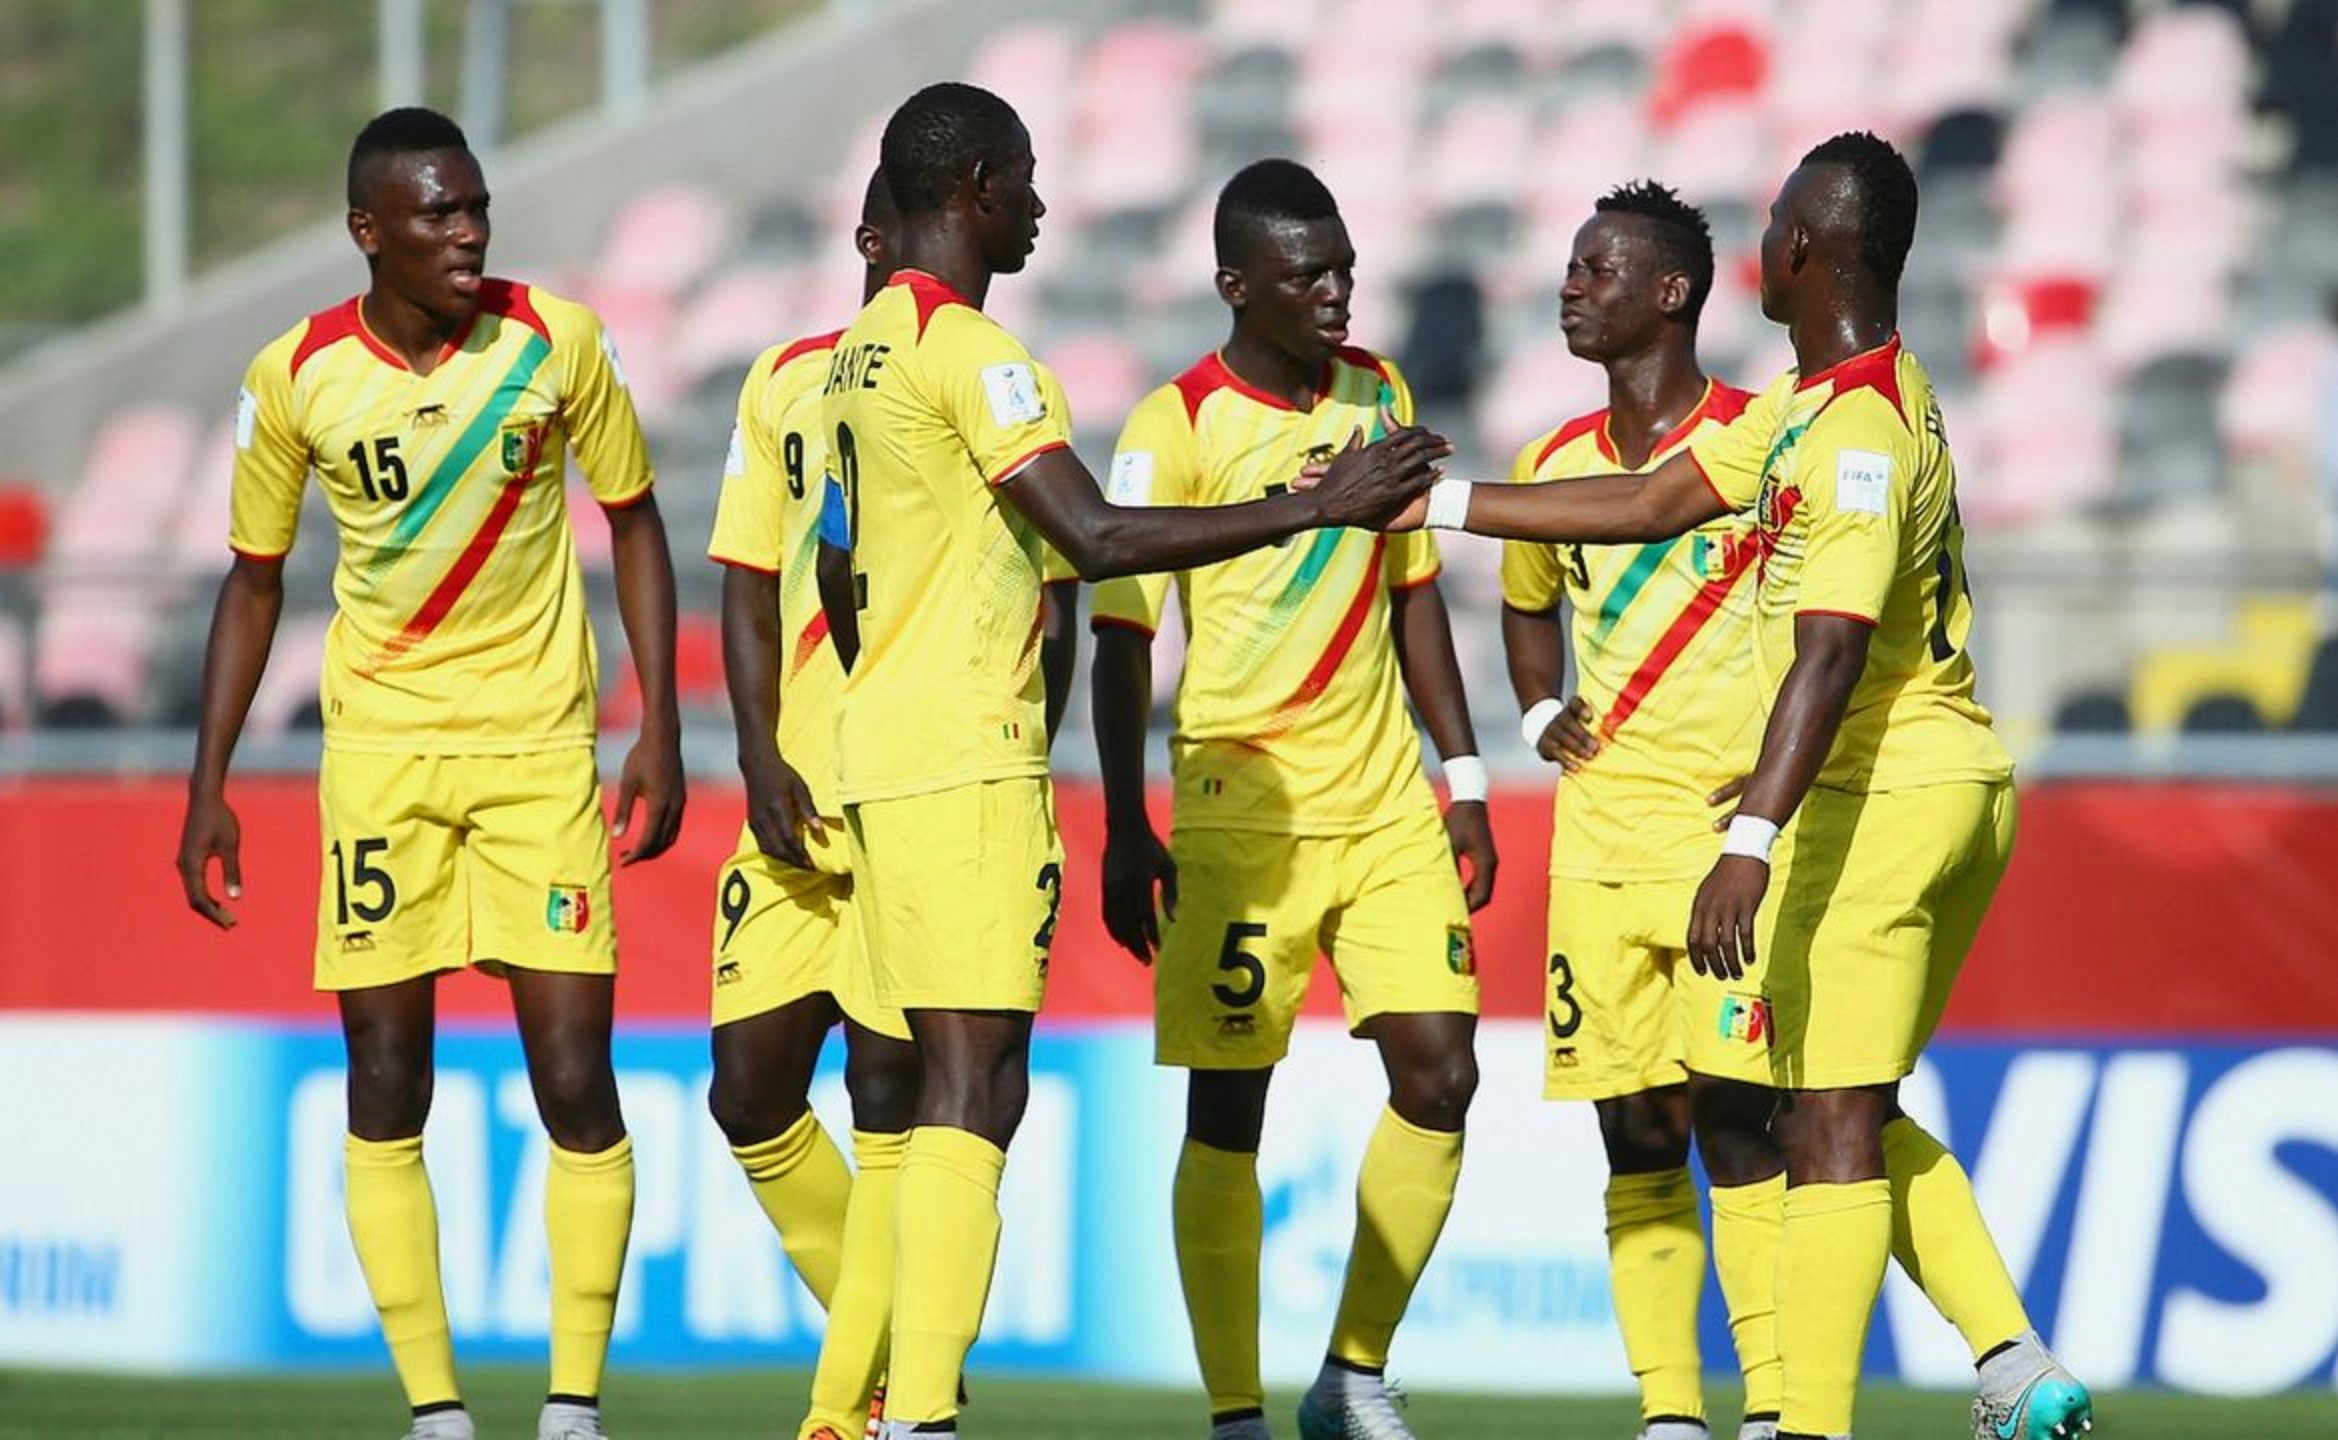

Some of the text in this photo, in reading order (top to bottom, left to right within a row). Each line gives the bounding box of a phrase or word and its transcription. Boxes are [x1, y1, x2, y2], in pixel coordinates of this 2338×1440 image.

[348, 436, 410, 501] 15
[784, 432, 805, 499] 9
[331, 837, 396, 925] 15
[720, 868, 751, 953] 9
[1033, 862, 1061, 949] 2
[1211, 922, 1267, 1008] 5
[1549, 953, 1583, 1039] 3
[1880, 1047, 2338, 1398] VIS
